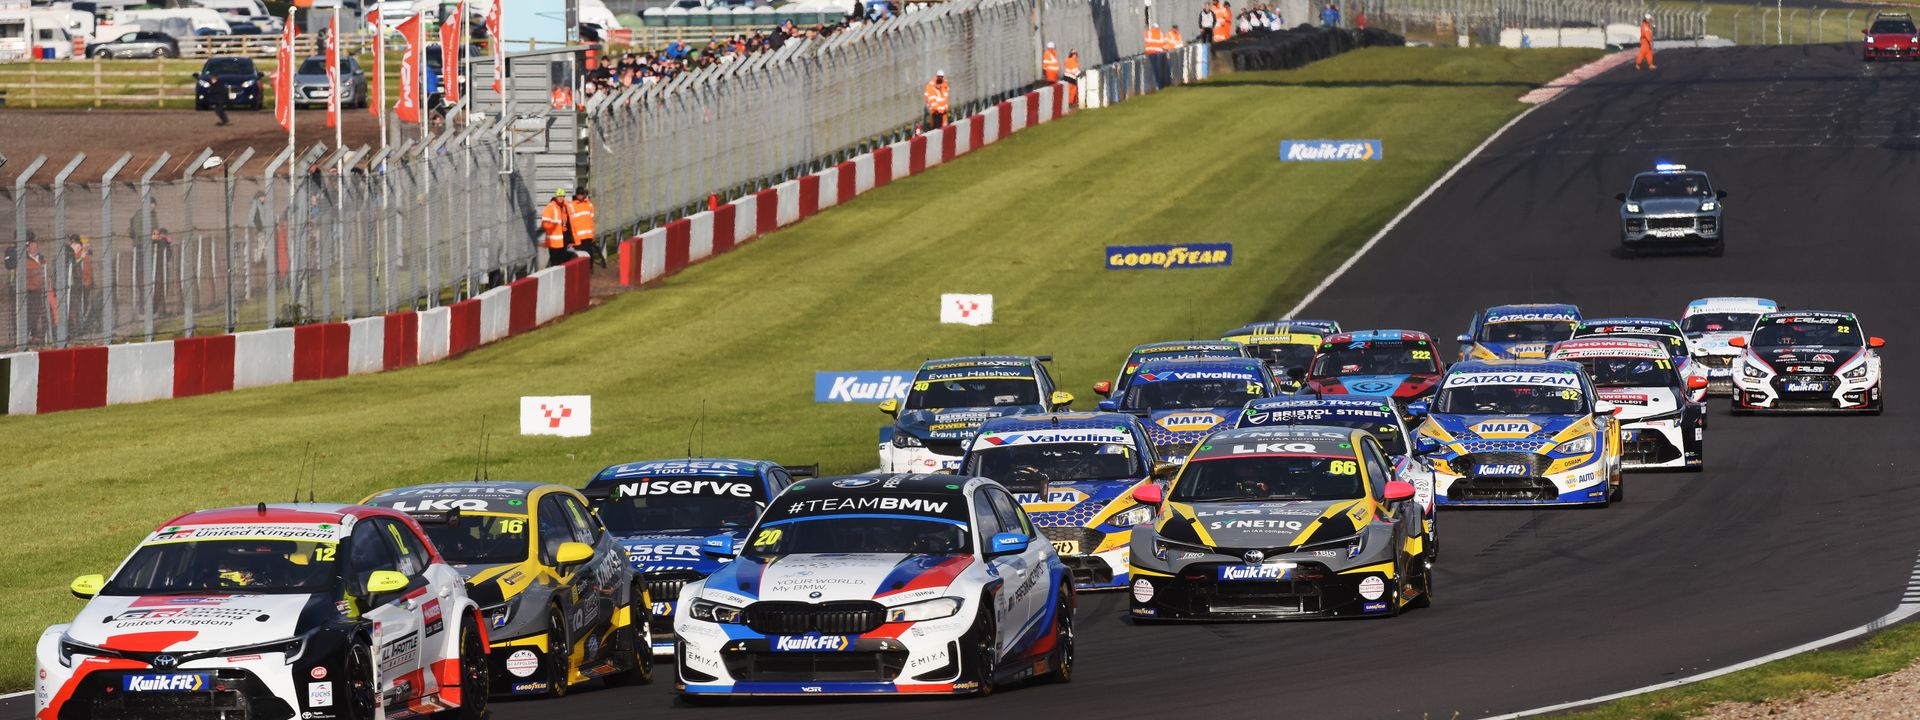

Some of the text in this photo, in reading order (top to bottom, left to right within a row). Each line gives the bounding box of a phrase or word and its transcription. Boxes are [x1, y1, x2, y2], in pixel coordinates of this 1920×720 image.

[1110, 247, 1228, 268] GOODYEAR
[1488, 313, 1575, 323] CATACLEAN
[1837, 325, 1850, 334] 22
[1670, 337, 1681, 346] 14
[1412, 350, 1431, 360] 222
[1655, 359, 1672, 370] 11
[928, 371, 963, 380] Evans
[1175, 371, 1253, 380] Valvoline
[1450, 374, 1575, 386] CATACLEAN
[913, 382, 930, 392] 40
[1246, 385, 1261, 395] 27
[1561, 390, 1578, 401] 32
[1272, 408, 1391, 418] BRISTOL STREET
[1167, 415, 1215, 426] NAPA
[1481, 423, 1530, 433] NAPA
[1027, 433, 1125, 443] Valvoline
[1233, 443, 1317, 454] LKQ
[1564, 457, 1582, 467] OSRAM
[616, 461, 739, 474] LASER
[1330, 460, 1357, 475] 66
[392, 498, 489, 512] LKQ
[788, 497, 949, 514] #TEAMBMW
[1198, 509, 1262, 517] LKQ
[499, 519, 523, 534] 16
[1211, 518, 1303, 531] SYNETIQ
[195, 529, 333, 539] United Kingdom
[753, 529, 780, 547] 20
[314, 547, 337, 562] 12
[776, 578, 814, 586] YOUR
[115, 617, 233, 629] United Kingdom
[515, 682, 547, 691] GOODYEAR
